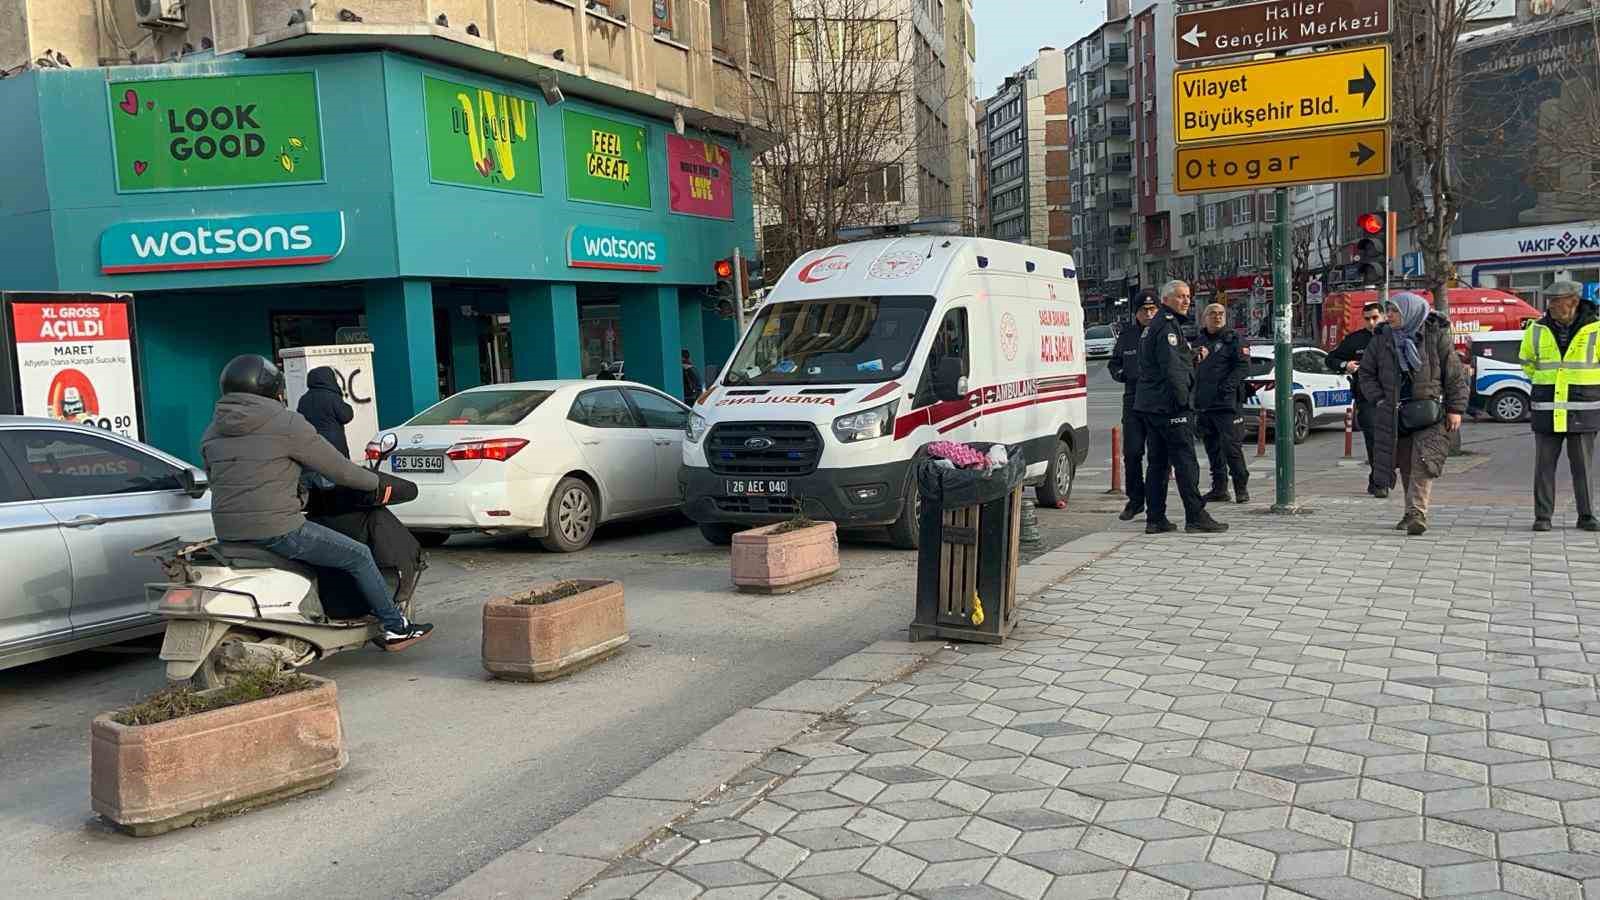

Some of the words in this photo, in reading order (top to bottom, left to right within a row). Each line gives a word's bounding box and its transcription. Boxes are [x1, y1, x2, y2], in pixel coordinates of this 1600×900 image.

[1266, 0, 1324, 21] Haller
[1215, 26, 1289, 49] Gençlik
[1300, 11, 1379, 38] Merkezi
[1183, 75, 1248, 99] Vilayet
[168, 104, 261, 133] LOOK
[1184, 101, 1294, 131] Büyükşehir
[1300, 96, 1339, 116] Bld.
[170, 133, 266, 161] GOOD
[593, 132, 621, 155] FEEL
[1185, 154, 1300, 179] Otogar
[131, 224, 312, 258] watsons
[583, 235, 656, 261] watsons
[1518, 237, 1555, 254] VAKIF
[1580, 234, 1600, 249] KA
[41, 308, 57, 318] XL
[60, 307, 100, 318] GROSS
[40, 320, 104, 340] AÇILDI
[54, 345, 94, 356] MARET
[995, 378, 1037, 401] AMBULANS
[114, 415, 131, 428] 90
[397, 457, 408, 468] 26
[411, 457, 424, 468] US
[425, 457, 442, 468] 640
[733, 480, 744, 492] 26
[748, 480, 765, 492] AEC
[768, 480, 786, 492] 040
